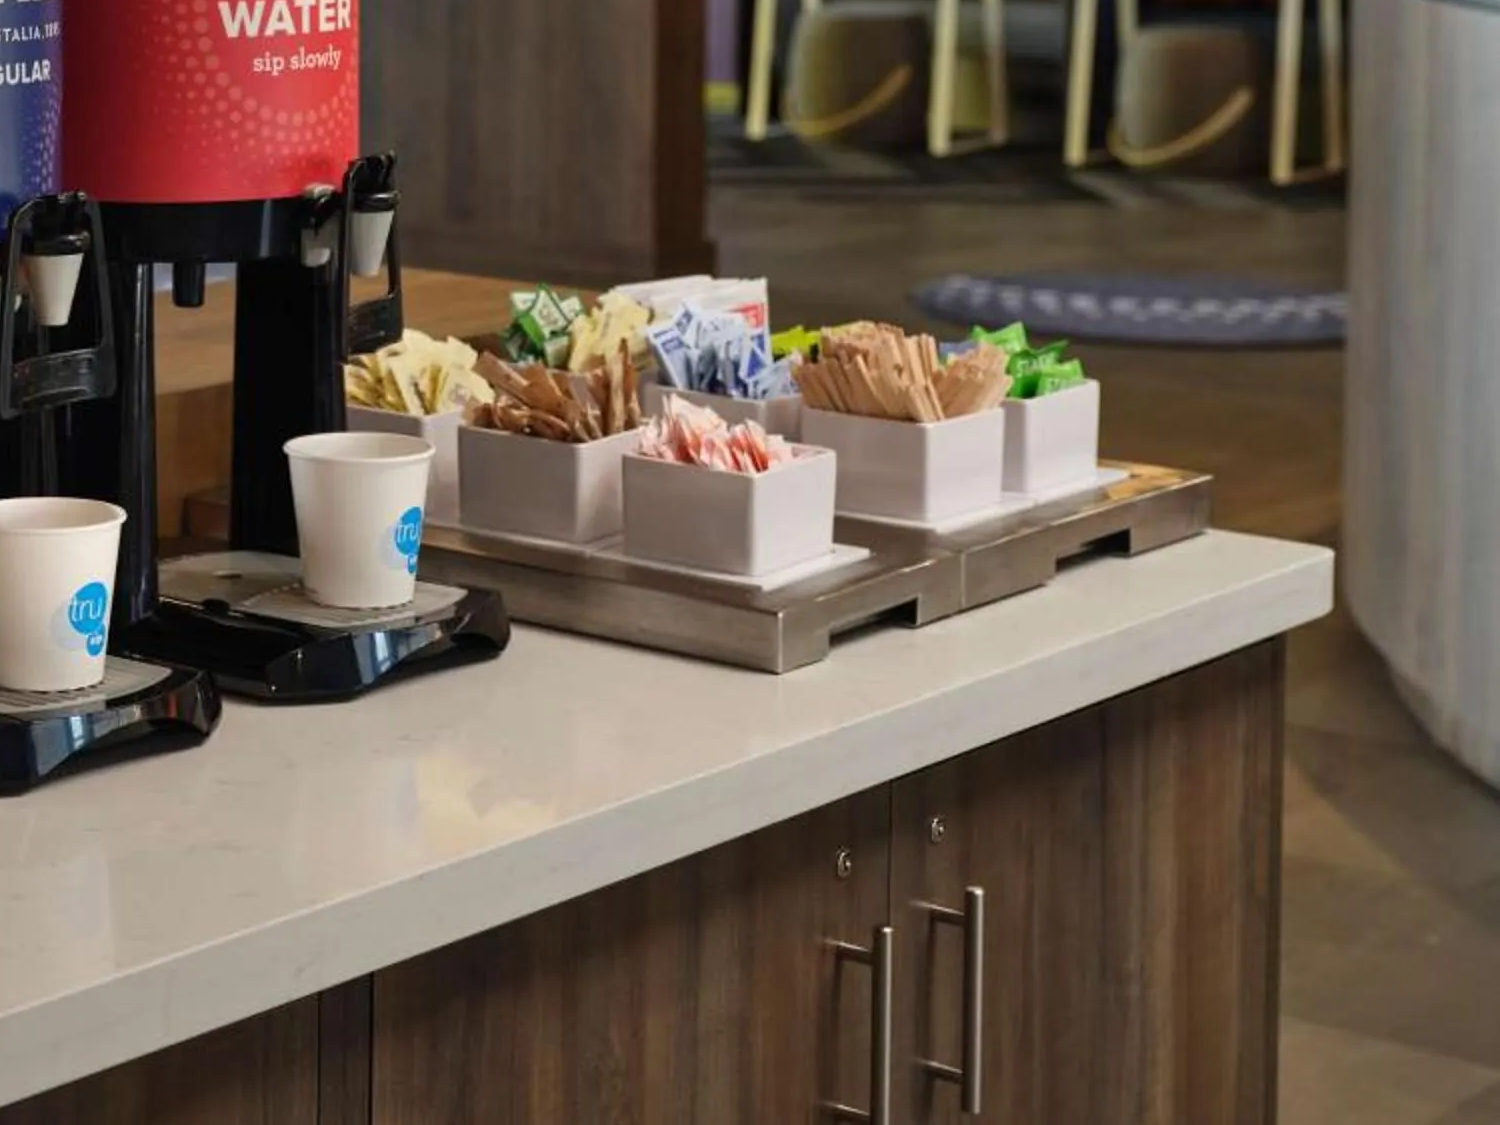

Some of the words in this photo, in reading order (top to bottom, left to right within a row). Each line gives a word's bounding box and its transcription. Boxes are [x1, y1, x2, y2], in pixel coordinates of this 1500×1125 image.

[253, 52, 285, 76] sip
[289, 43, 341, 70] slowly
[72, 596, 103, 622] tru
